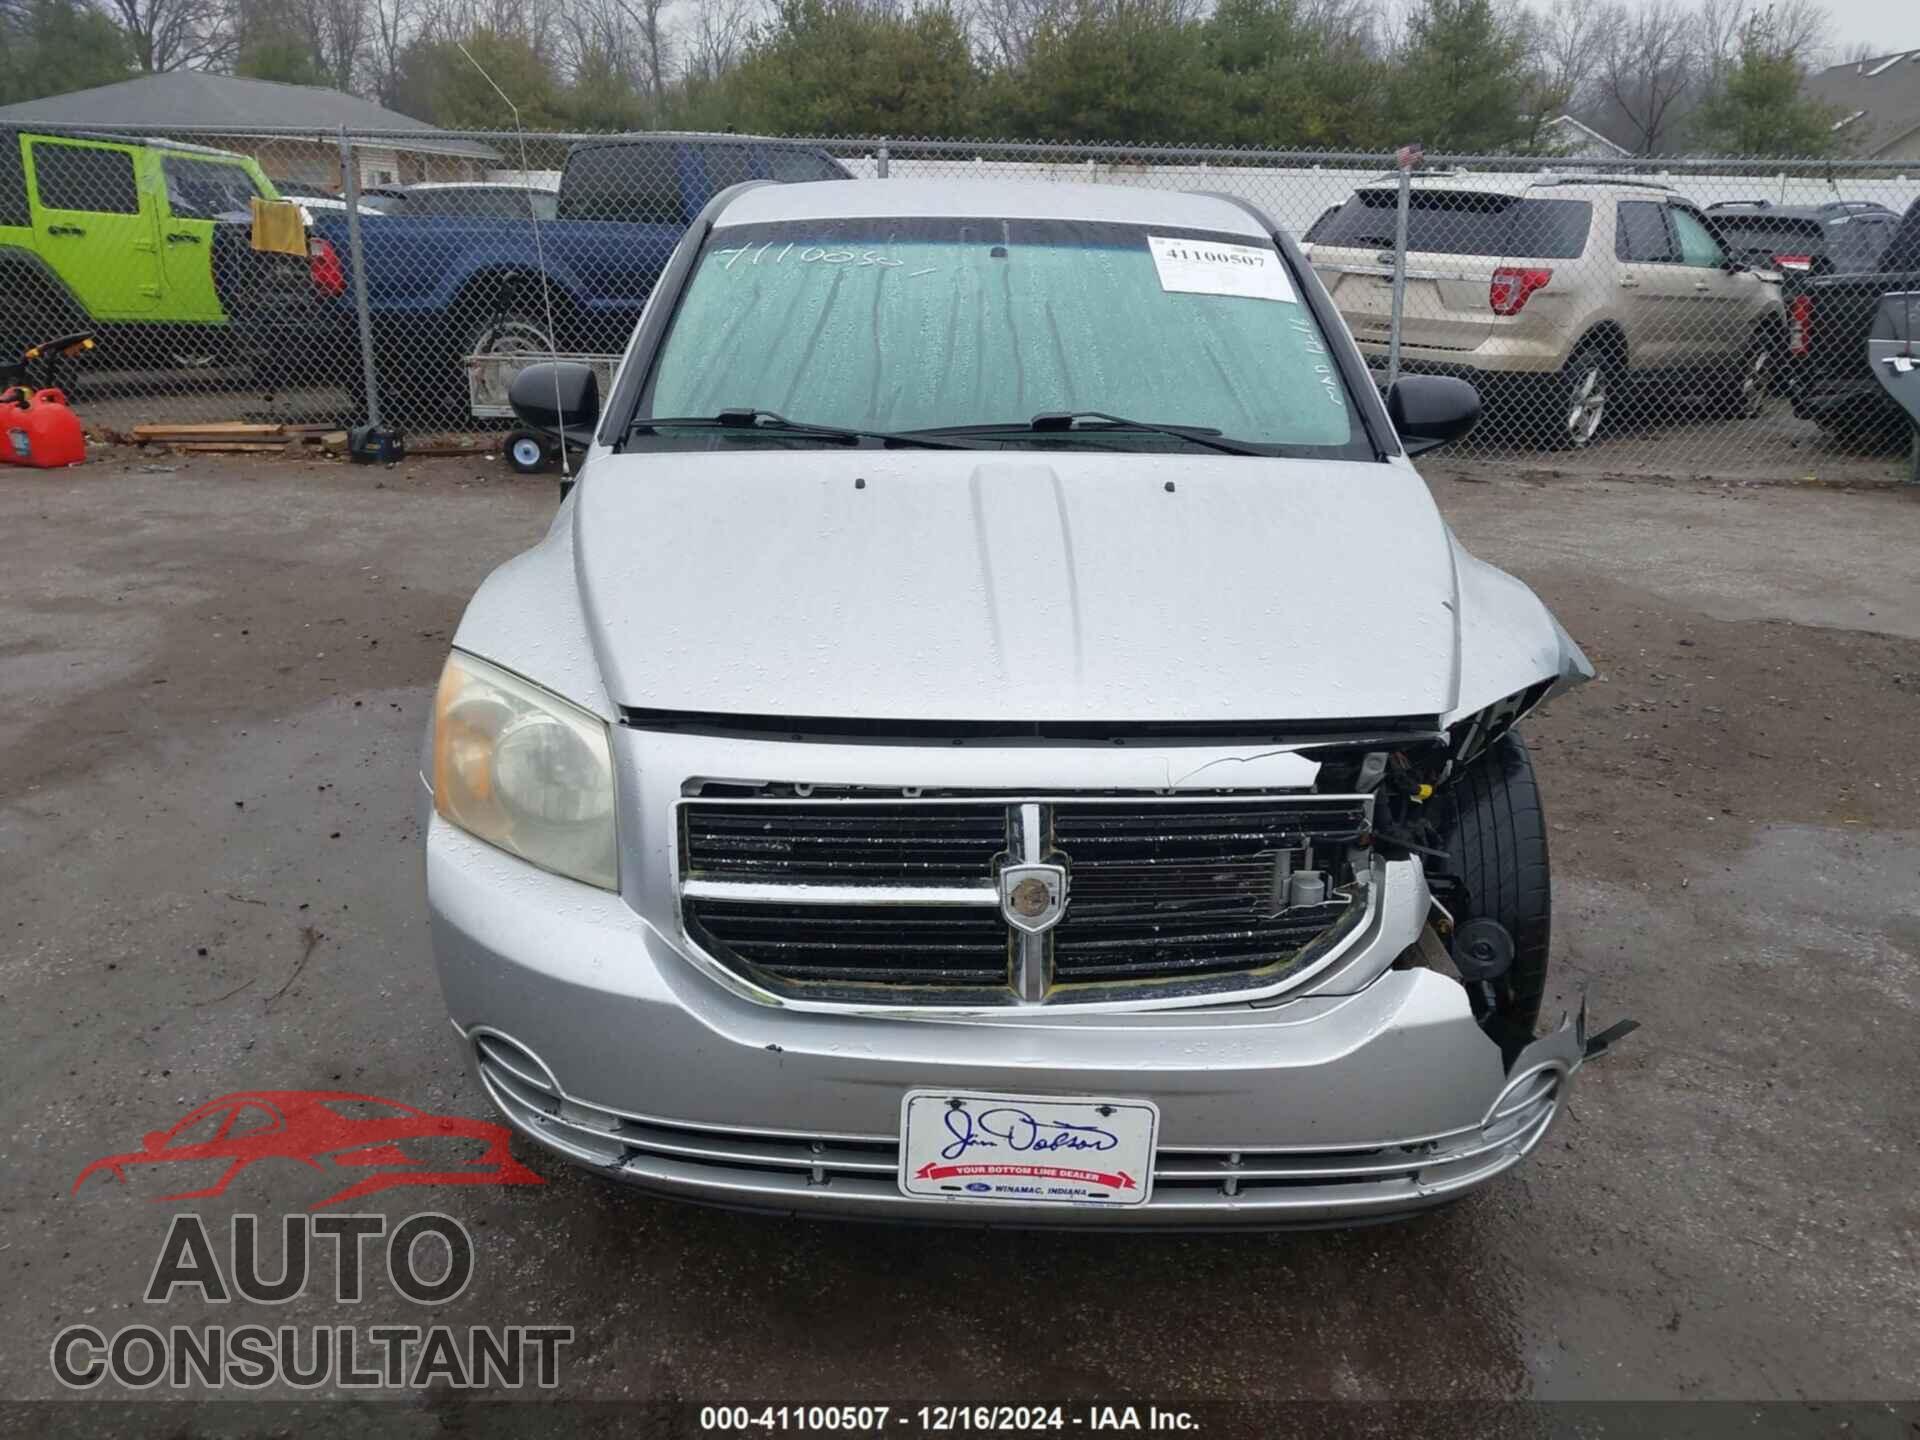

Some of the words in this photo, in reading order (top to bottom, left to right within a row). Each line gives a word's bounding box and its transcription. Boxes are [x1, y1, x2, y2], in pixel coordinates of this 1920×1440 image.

[1166, 249, 1265, 267] 41100507
[956, 1166, 987, 1175] YOUR
[987, 1166, 1032, 1175] BOTTOM
[1033, 1167, 1057, 1177] LINE
[1059, 1169, 1099, 1182] DEALER
[995, 1185, 1044, 1195] WINAMAC,
[1047, 1187, 1087, 1196] INDIANA
